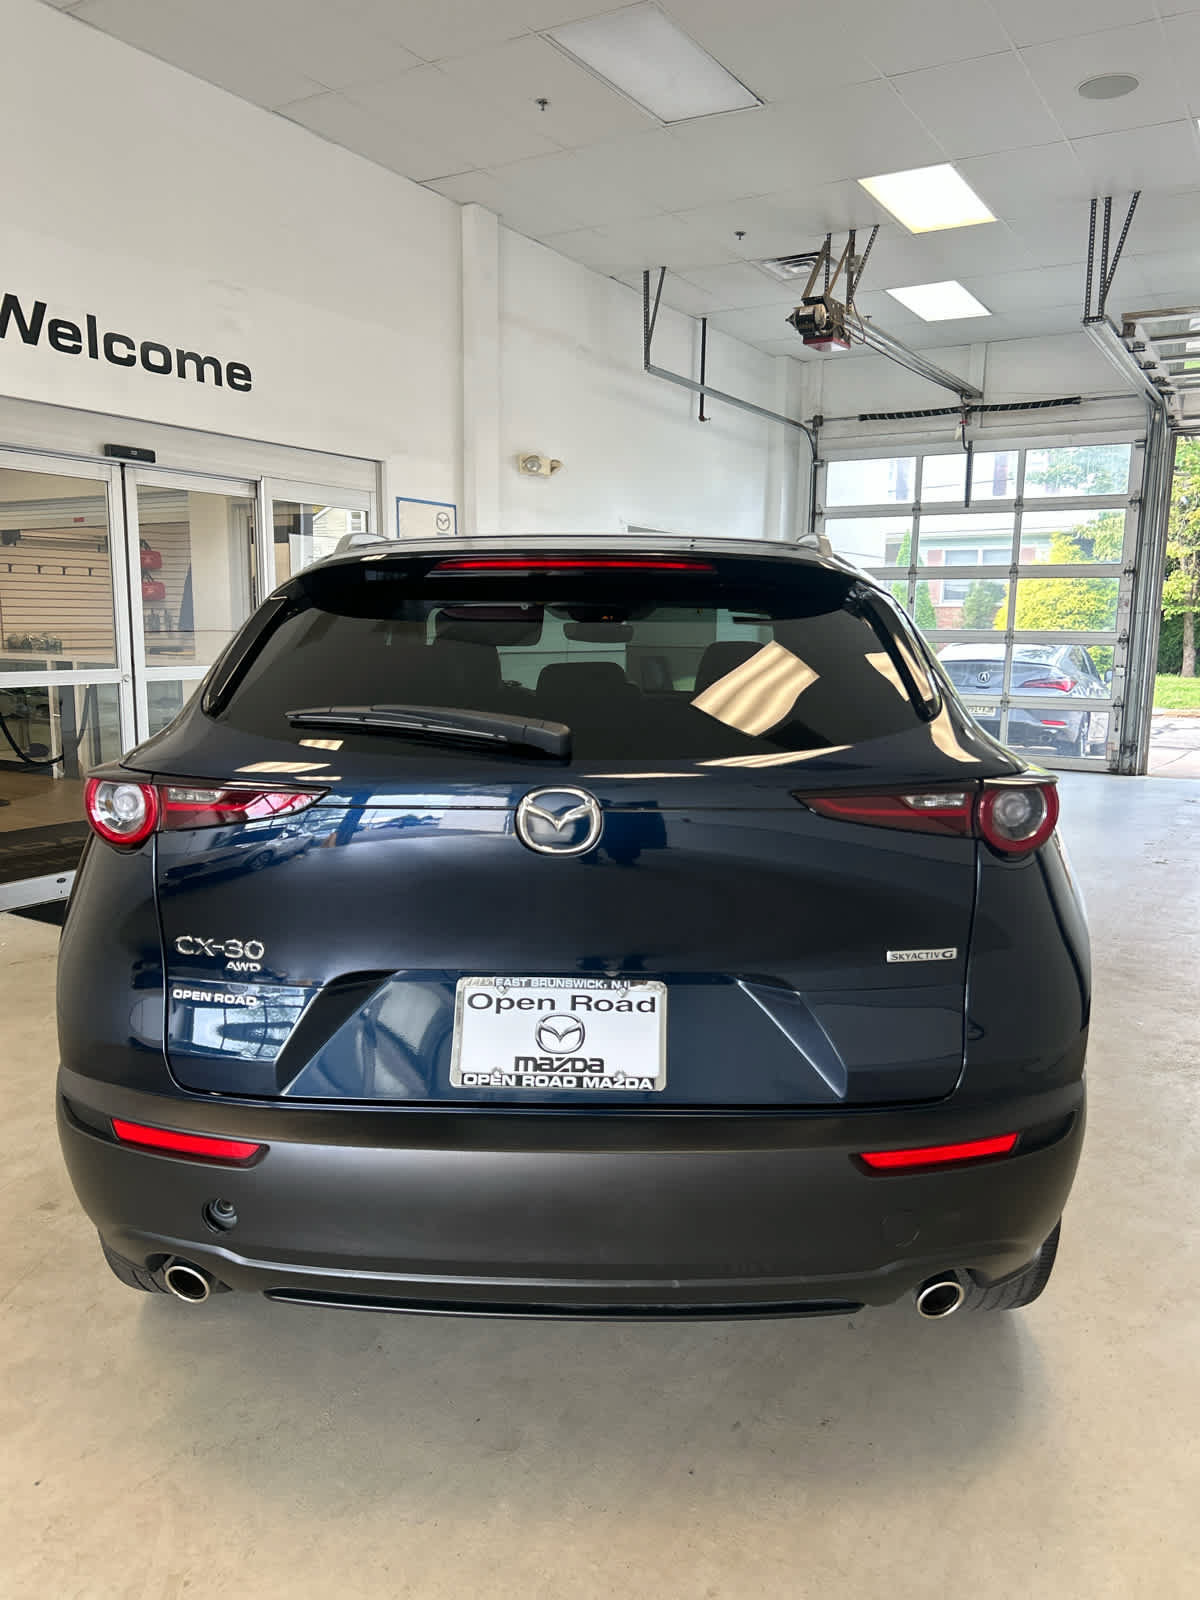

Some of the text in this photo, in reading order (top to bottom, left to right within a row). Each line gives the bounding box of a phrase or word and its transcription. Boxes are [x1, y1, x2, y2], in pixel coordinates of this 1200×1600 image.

[0, 293, 252, 392] Welcome
[175, 935, 265, 960] CX-30
[225, 961, 262, 972] AWD
[496, 979, 527, 988] EAST
[530, 978, 608, 989] BRUNSWICK,
[172, 989, 258, 1007] OPEN ROAD
[467, 993, 656, 1014] Open Road
[463, 1073, 653, 1090] OPEN ROAD MAZDA
